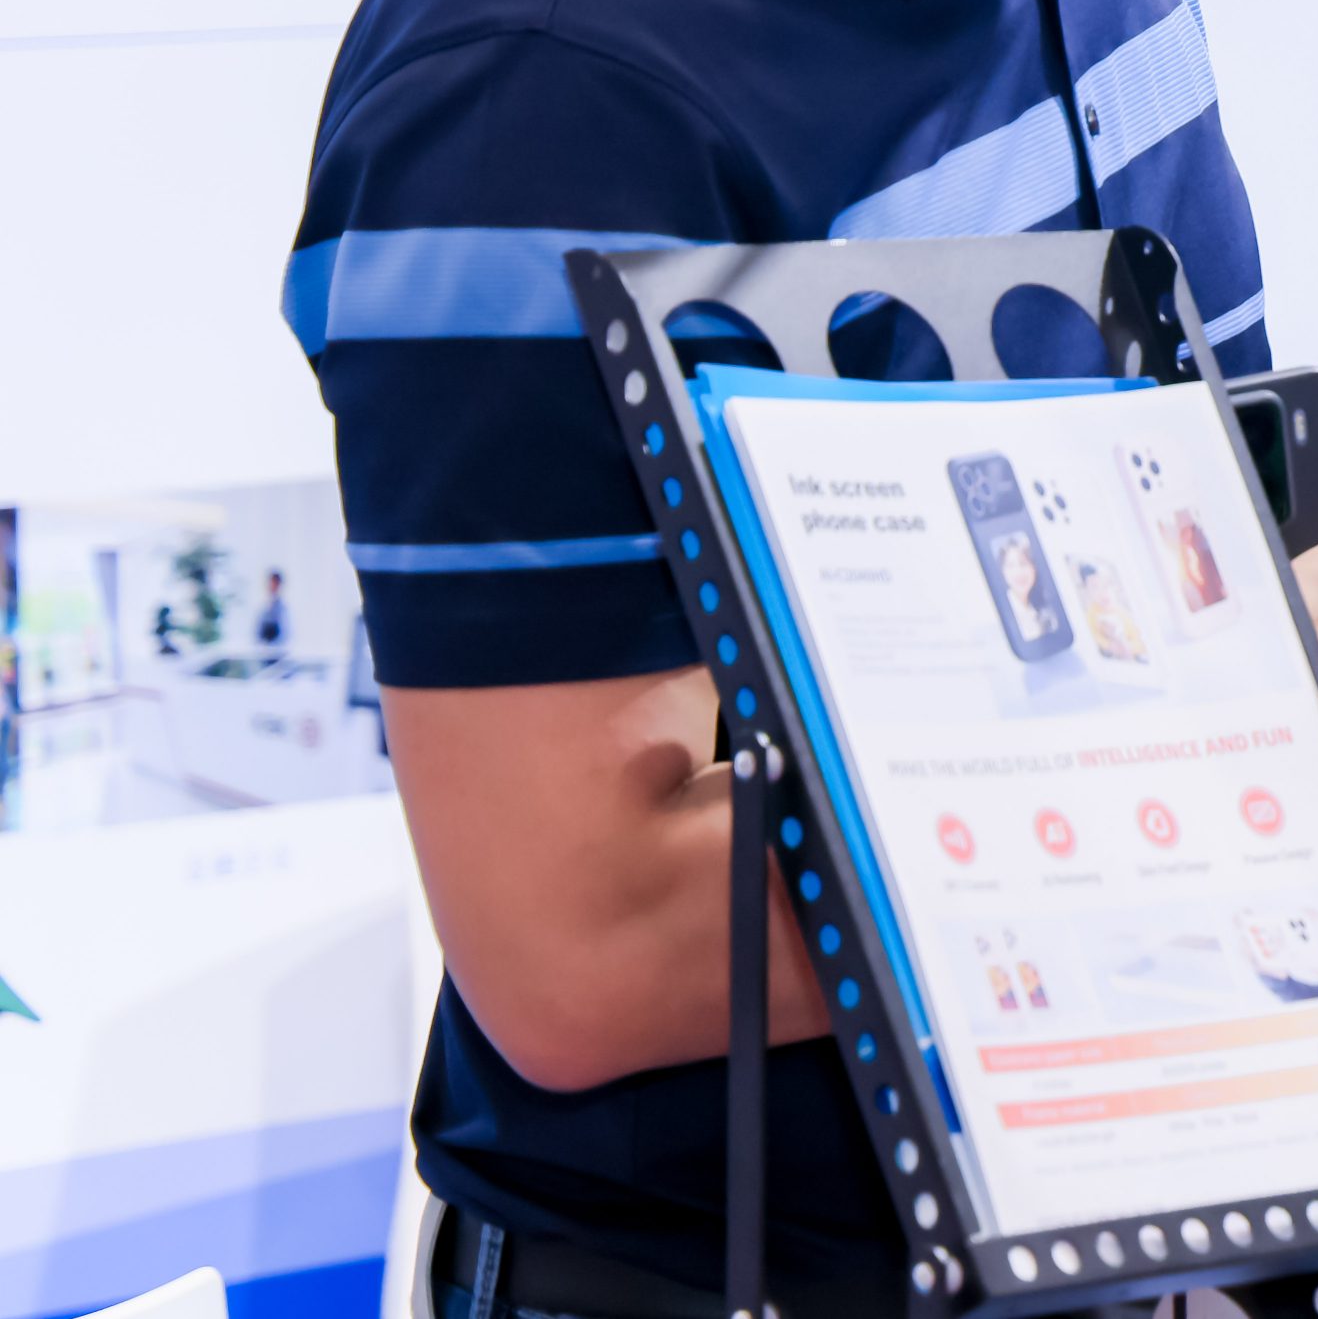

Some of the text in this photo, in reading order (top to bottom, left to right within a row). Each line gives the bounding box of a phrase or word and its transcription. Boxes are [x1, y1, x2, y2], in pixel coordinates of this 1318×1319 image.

[829, 480, 906, 497] screen
[801, 508, 927, 536] phone case
[1077, 739, 1201, 768] INTELLIGENCE
[1205, 732, 1249, 757] AND
[1252, 725, 1294, 750] FUN
